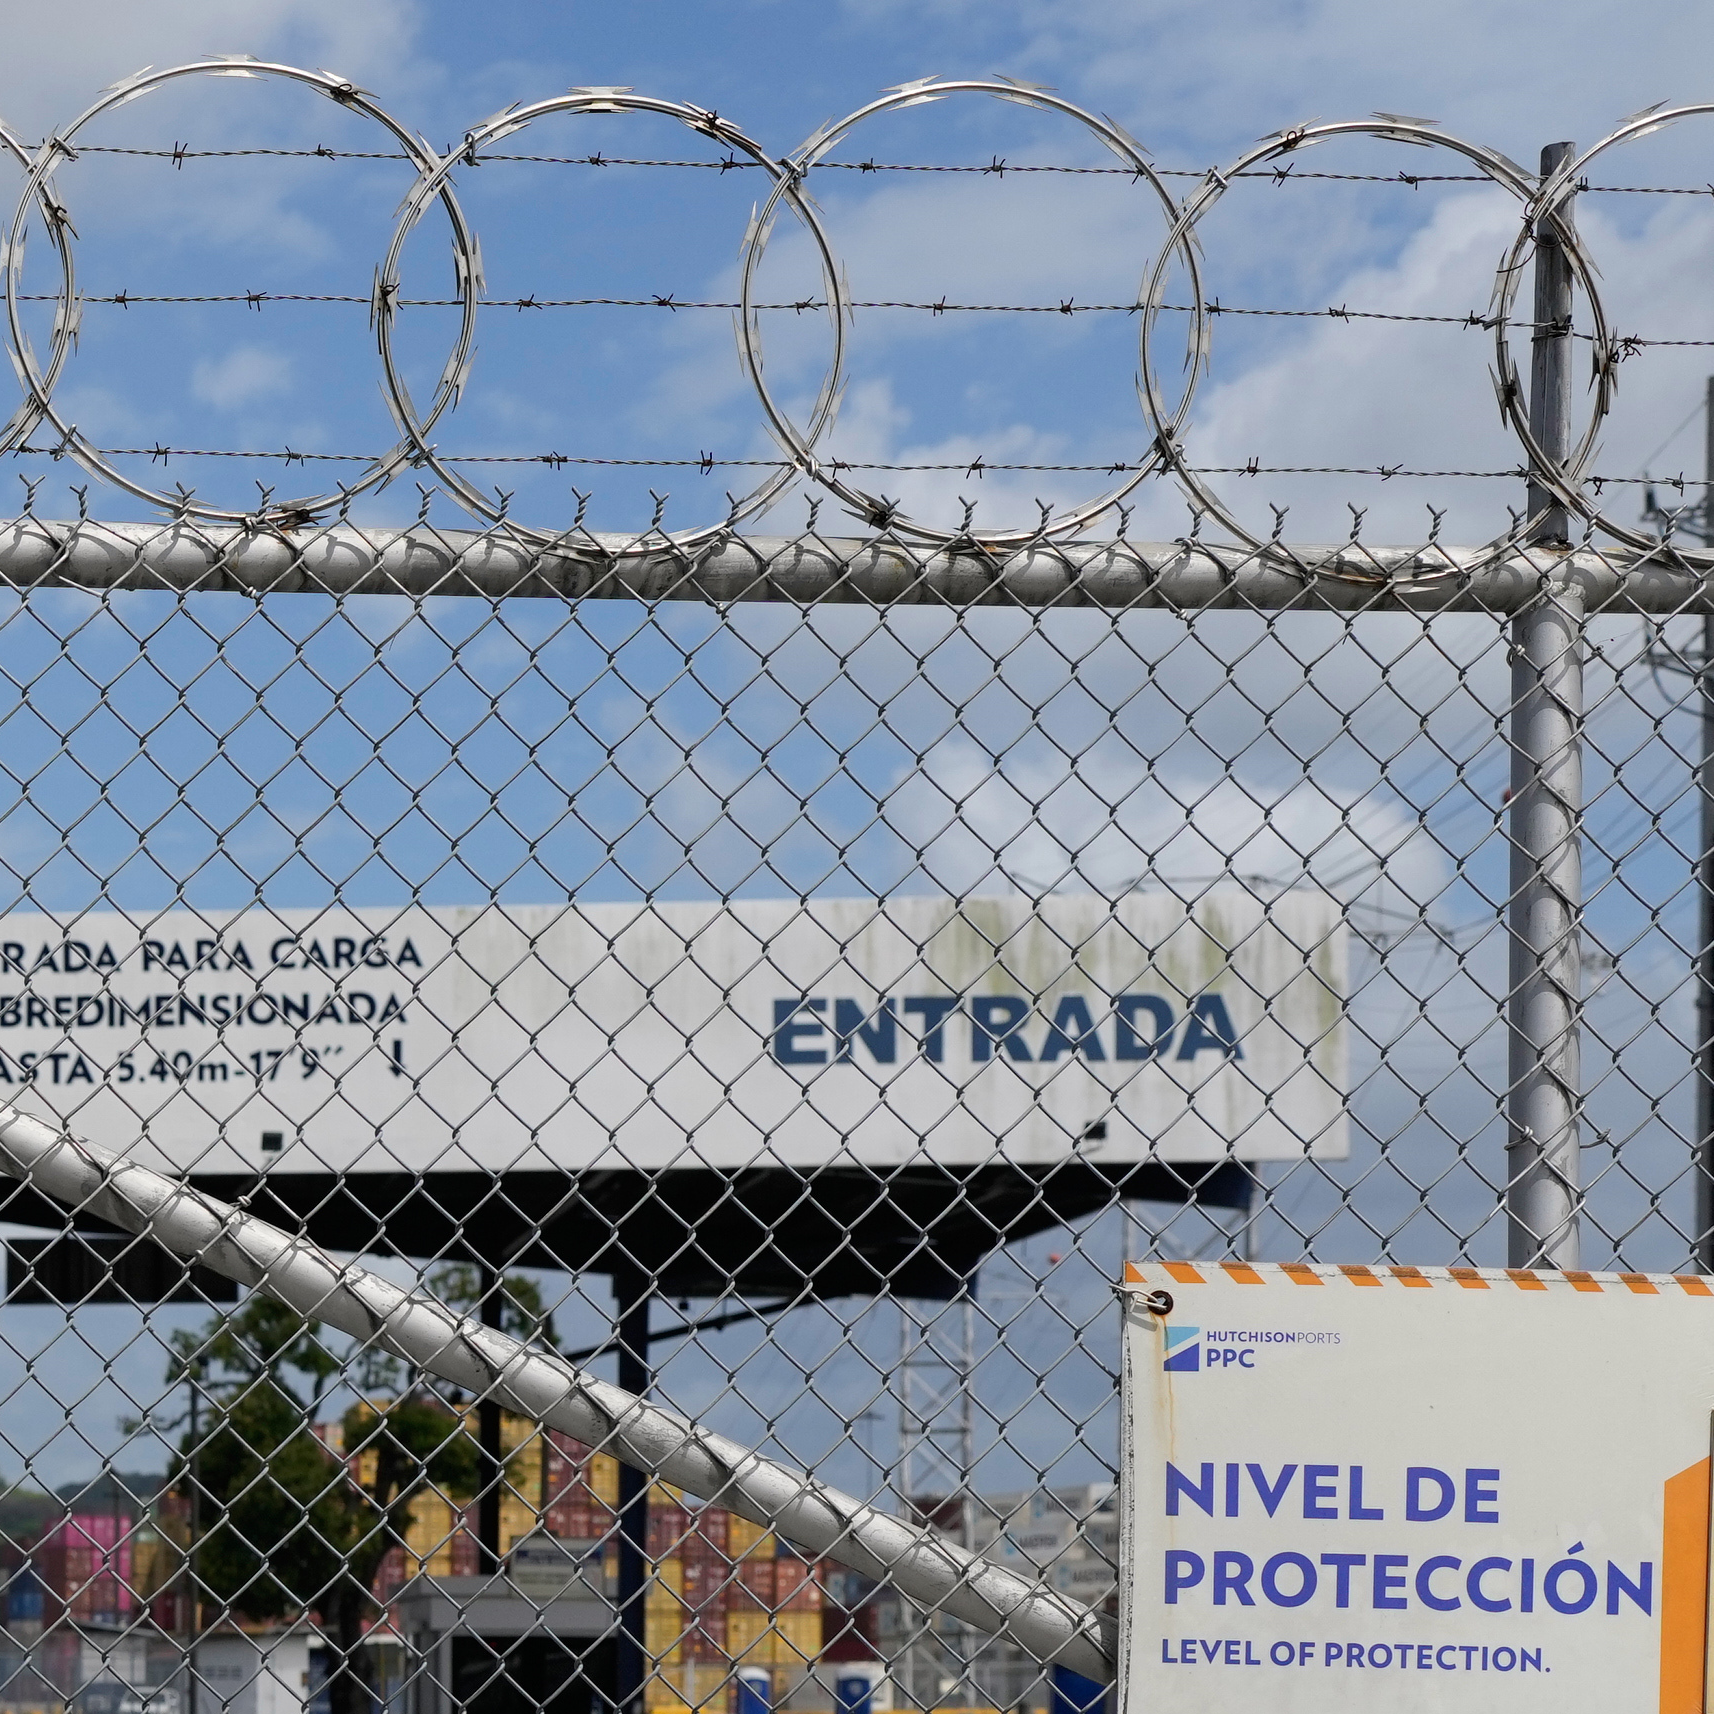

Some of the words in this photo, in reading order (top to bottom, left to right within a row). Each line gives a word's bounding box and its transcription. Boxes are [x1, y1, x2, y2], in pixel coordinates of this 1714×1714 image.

[142, 939, 254, 973] PARA
[269, 936, 423, 970] CARGA
[773, 993, 1245, 1064] ENTRADA
[1206, 1330, 1341, 1344] HUTCHISONPORTS
[1206, 1348, 1255, 1368] PPC
[1165, 1460, 1383, 1522] NIVEL
[1405, 1466, 1500, 1524] DE
[1164, 1540, 1653, 1617] PROTECCIÓN
[1161, 1638, 1261, 1665] LEVEL
[1270, 1640, 1316, 1666] OF
[1324, 1642, 1551, 1672] PROTECTION.
